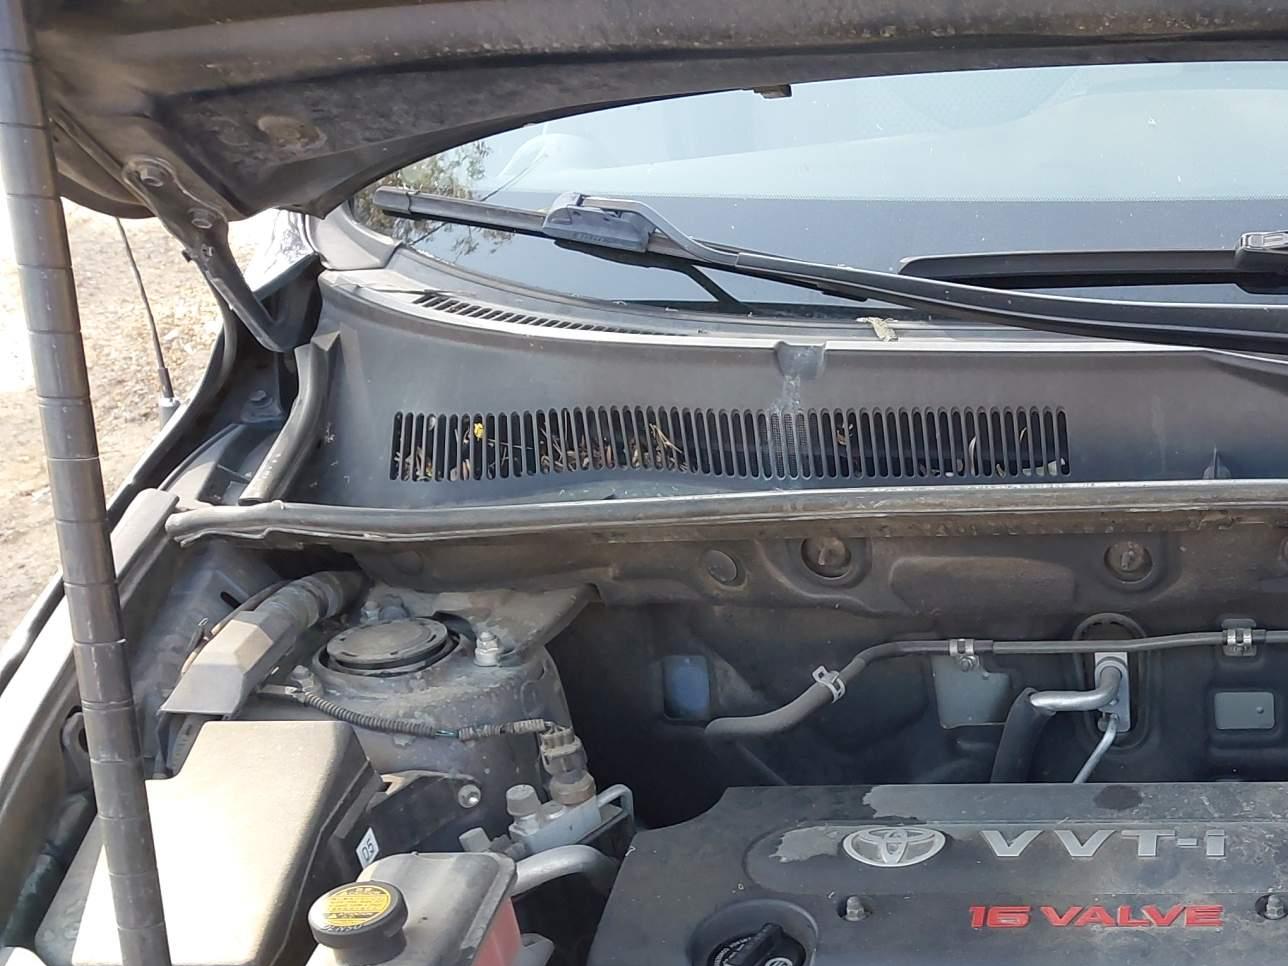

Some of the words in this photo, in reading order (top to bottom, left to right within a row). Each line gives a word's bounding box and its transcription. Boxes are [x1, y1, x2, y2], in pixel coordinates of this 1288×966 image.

[981, 829, 1226, 857] VVT-i
[968, 904, 1032, 928] 16
[1040, 904, 1225, 928] VALVE
